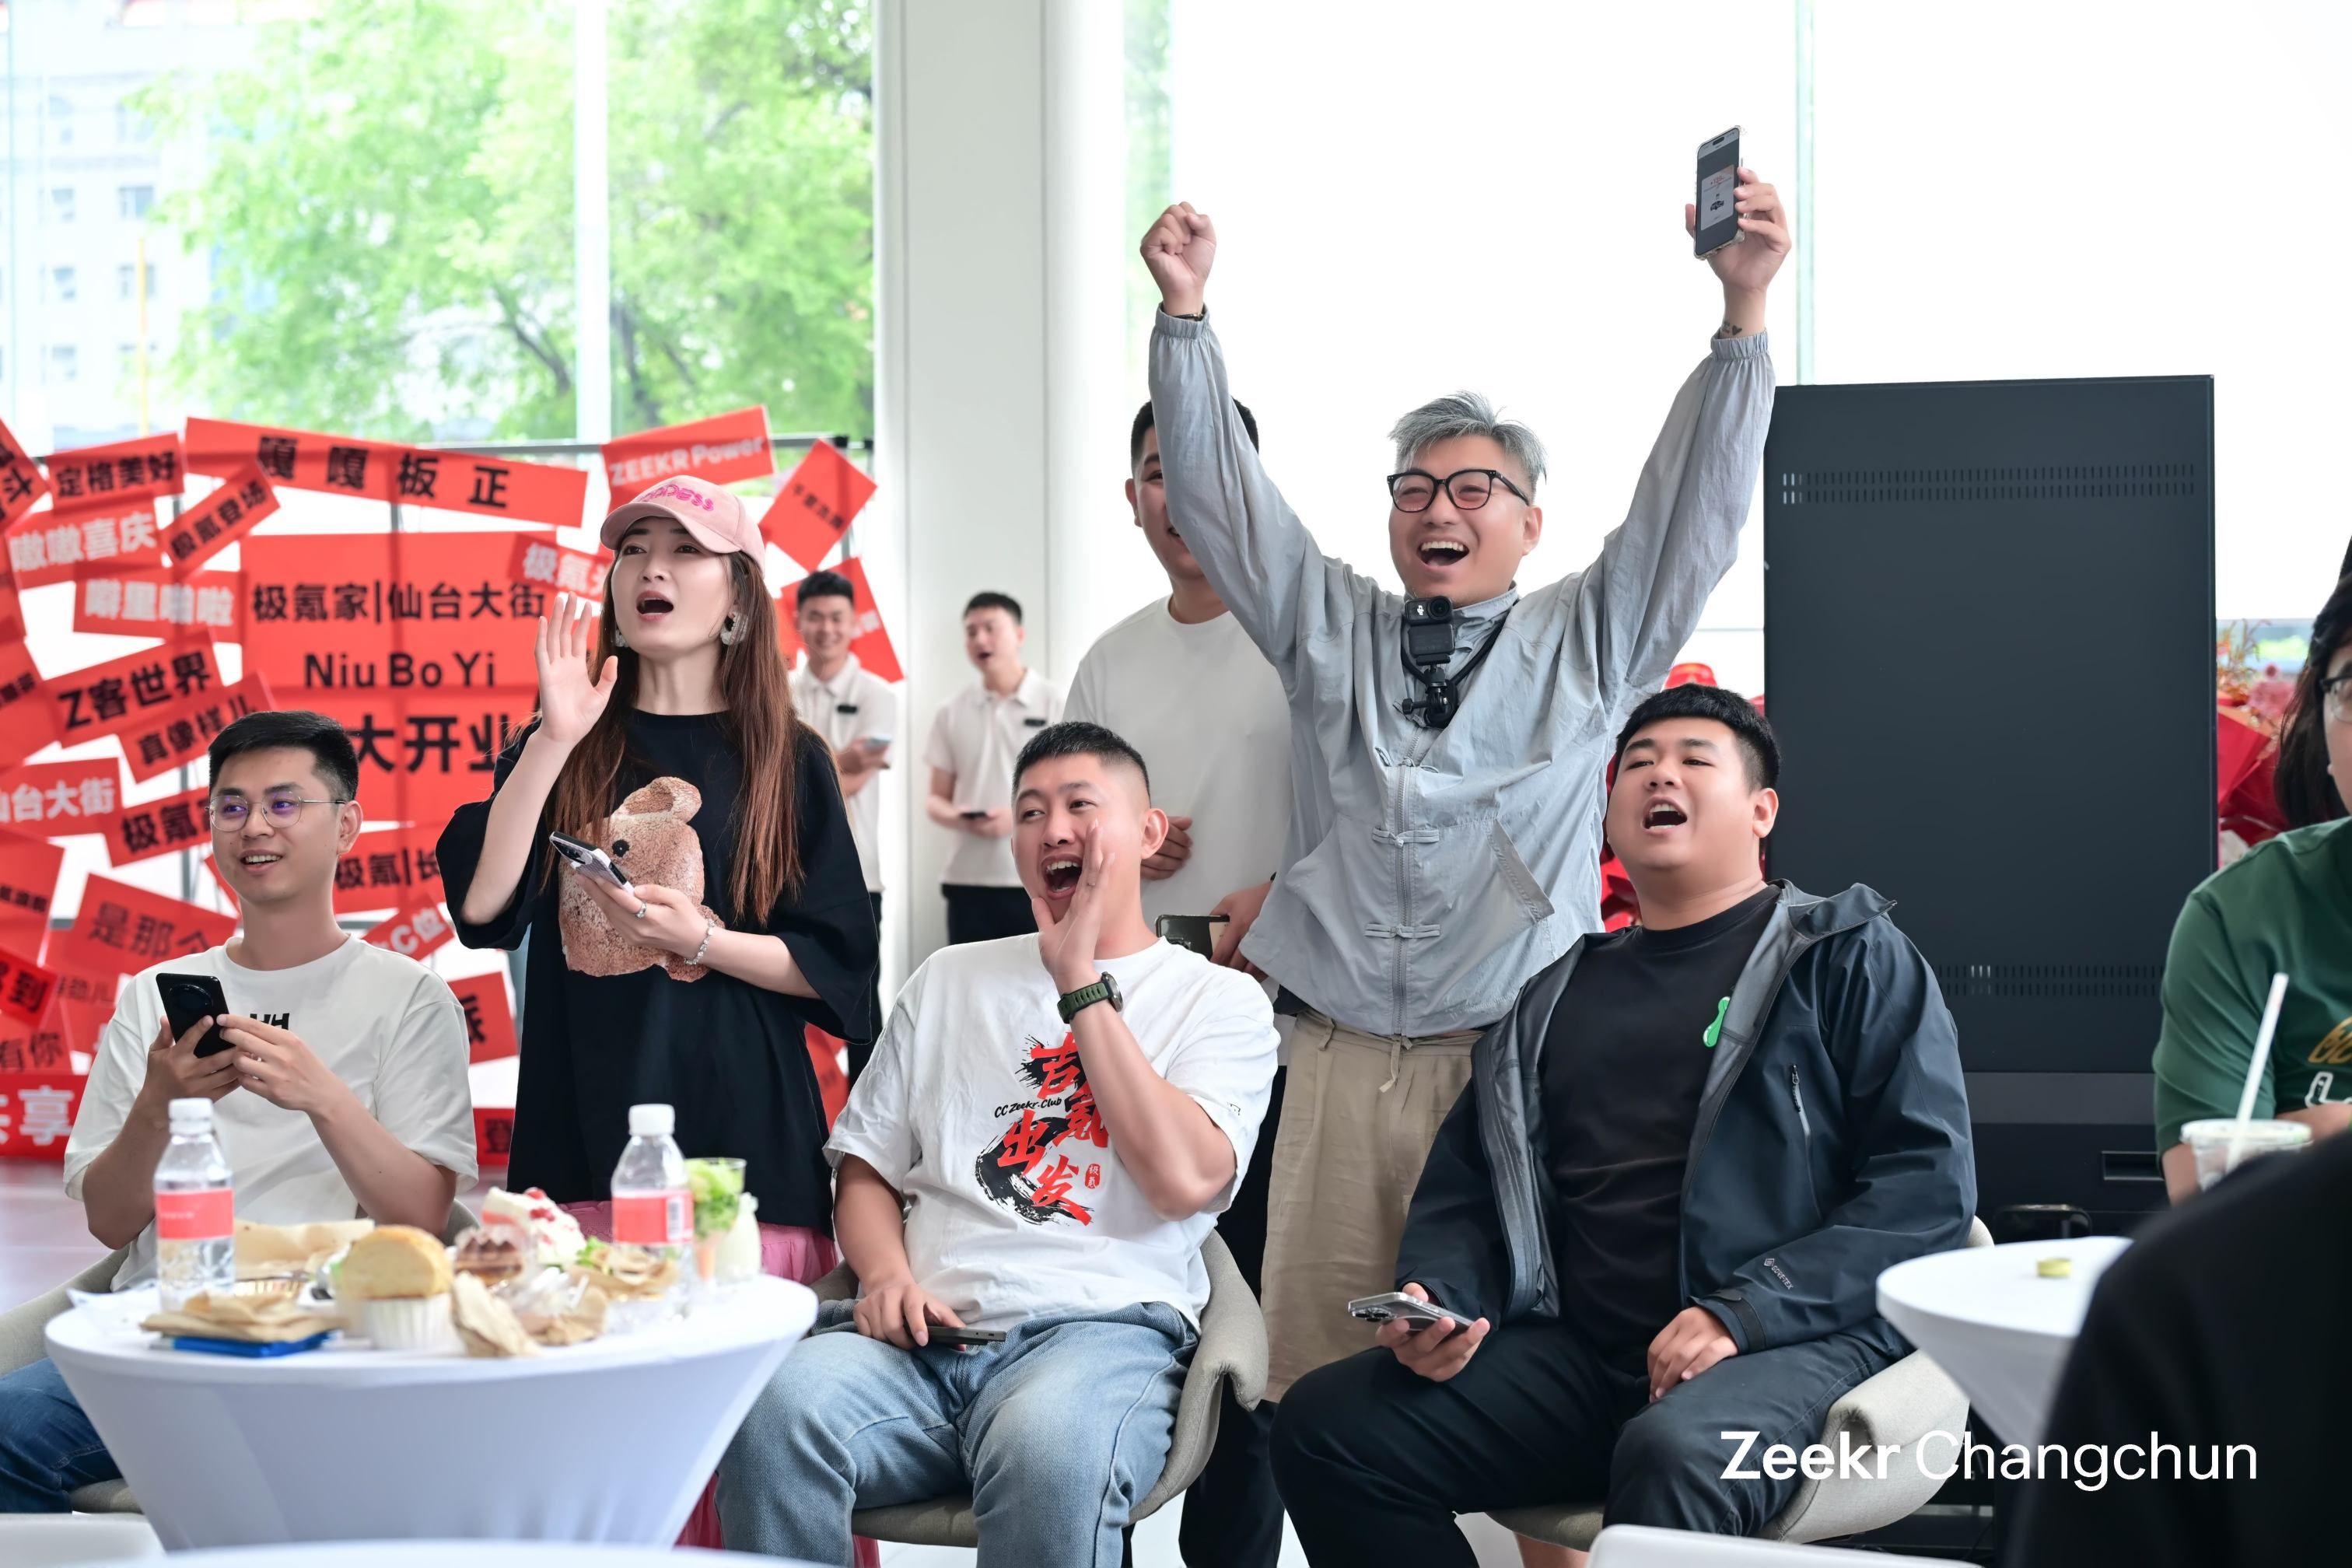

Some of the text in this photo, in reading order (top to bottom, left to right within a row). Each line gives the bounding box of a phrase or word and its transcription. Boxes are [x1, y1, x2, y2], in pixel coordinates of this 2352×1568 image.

[55, 450, 176, 499] 定格美好
[610, 436, 764, 487] ZEEKR Power
[58, 650, 212, 730] Z客世界
[304, 650, 496, 689] Niu Bo Yi
[370, 906, 446, 956] C位
[0, 961, 48, 1012] 到
[1771, 1265, 1794, 1290] GORE-TEX
